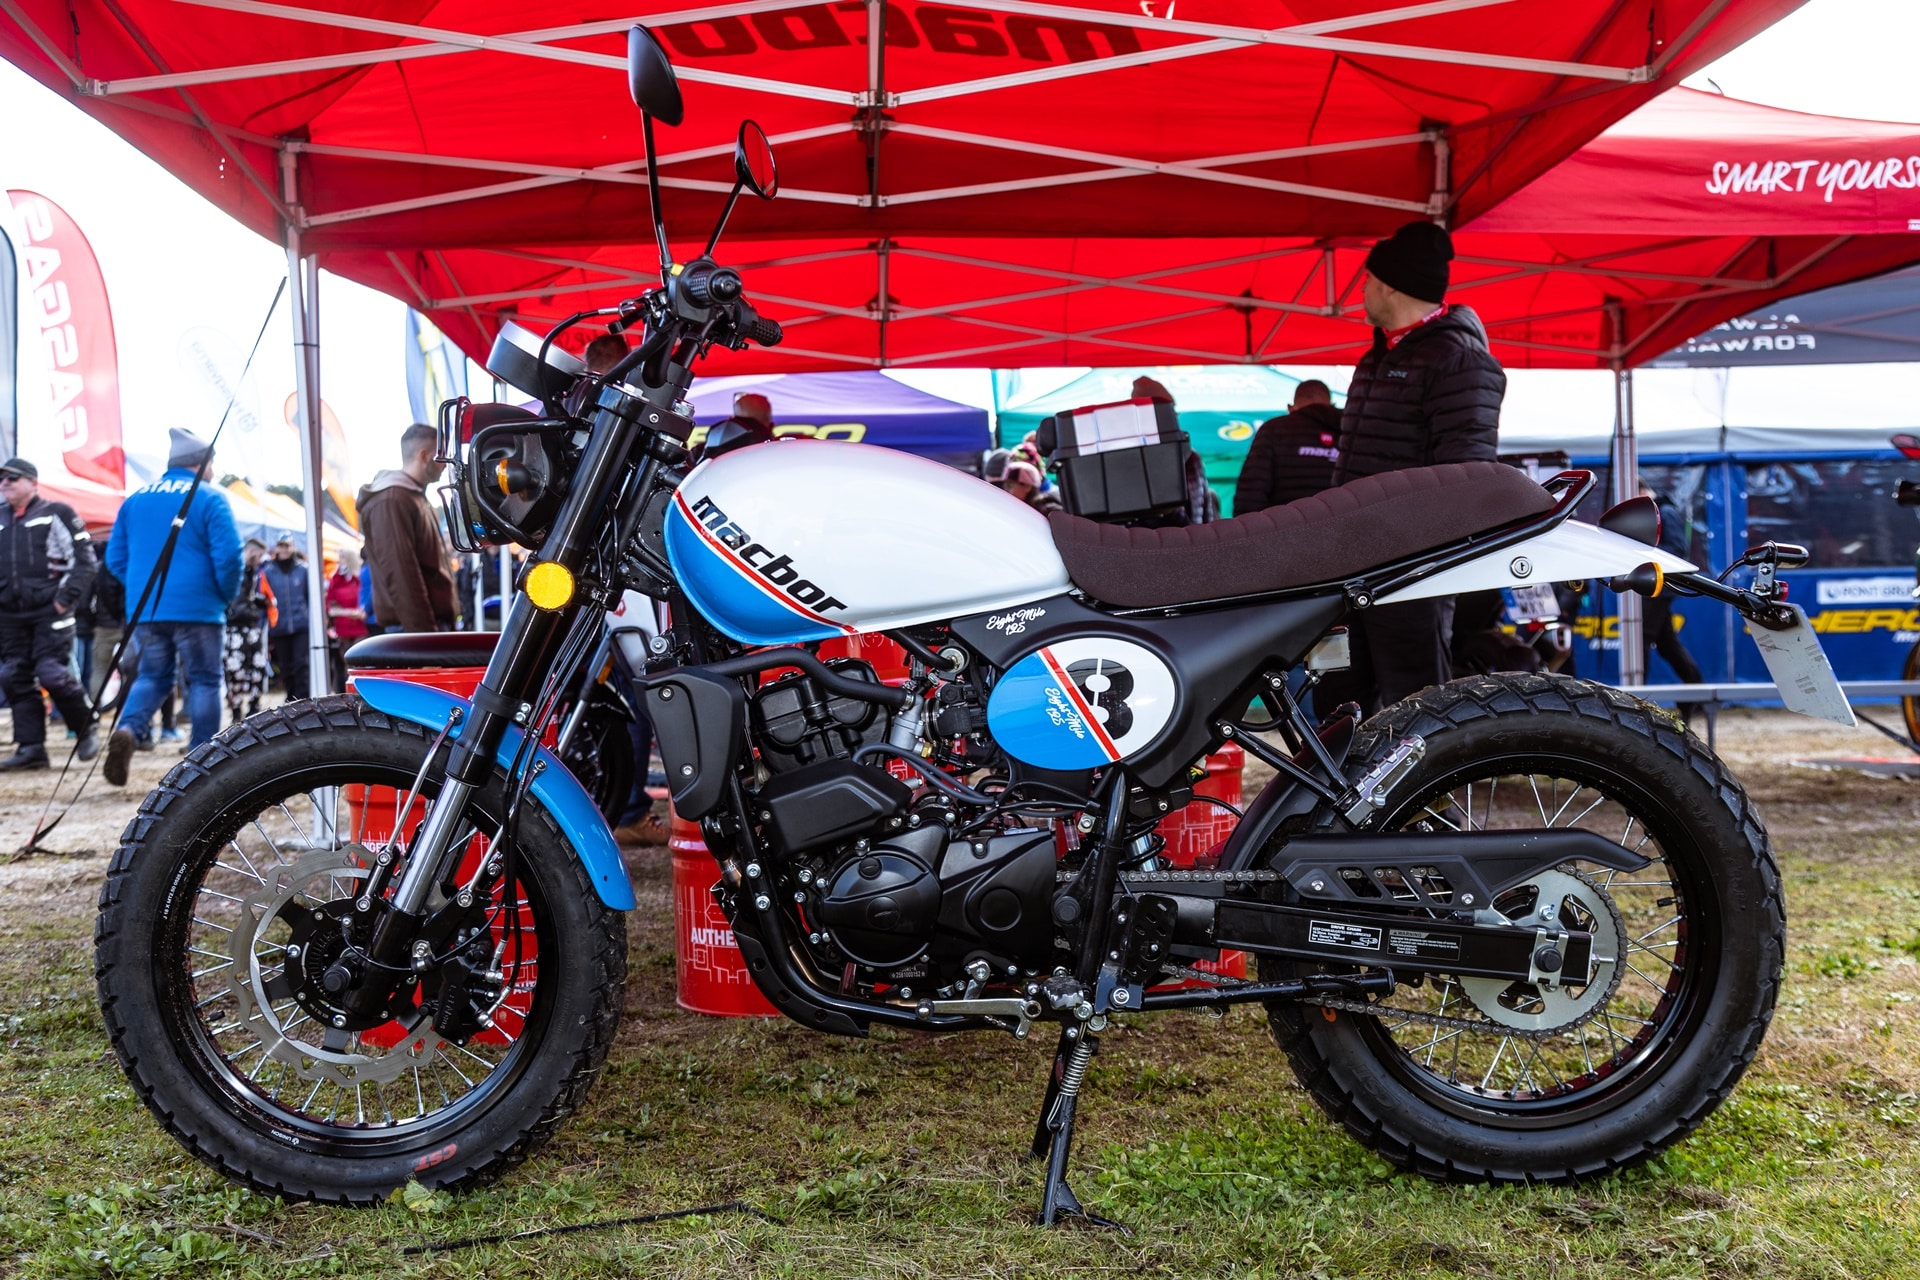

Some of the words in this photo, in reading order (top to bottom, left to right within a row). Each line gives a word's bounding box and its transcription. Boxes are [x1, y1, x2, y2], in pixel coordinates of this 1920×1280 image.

[1705, 160, 1819, 195] SMART
[1816, 155, 1920, 203] YOURS
[139, 479, 193, 494] STAFF
[691, 495, 848, 613] macbor
[986, 610, 1016, 630] Eight
[1045, 687, 1070, 716] Eight
[691, 927, 738, 946] AUTHE
[414, 1143, 457, 1172] CST
